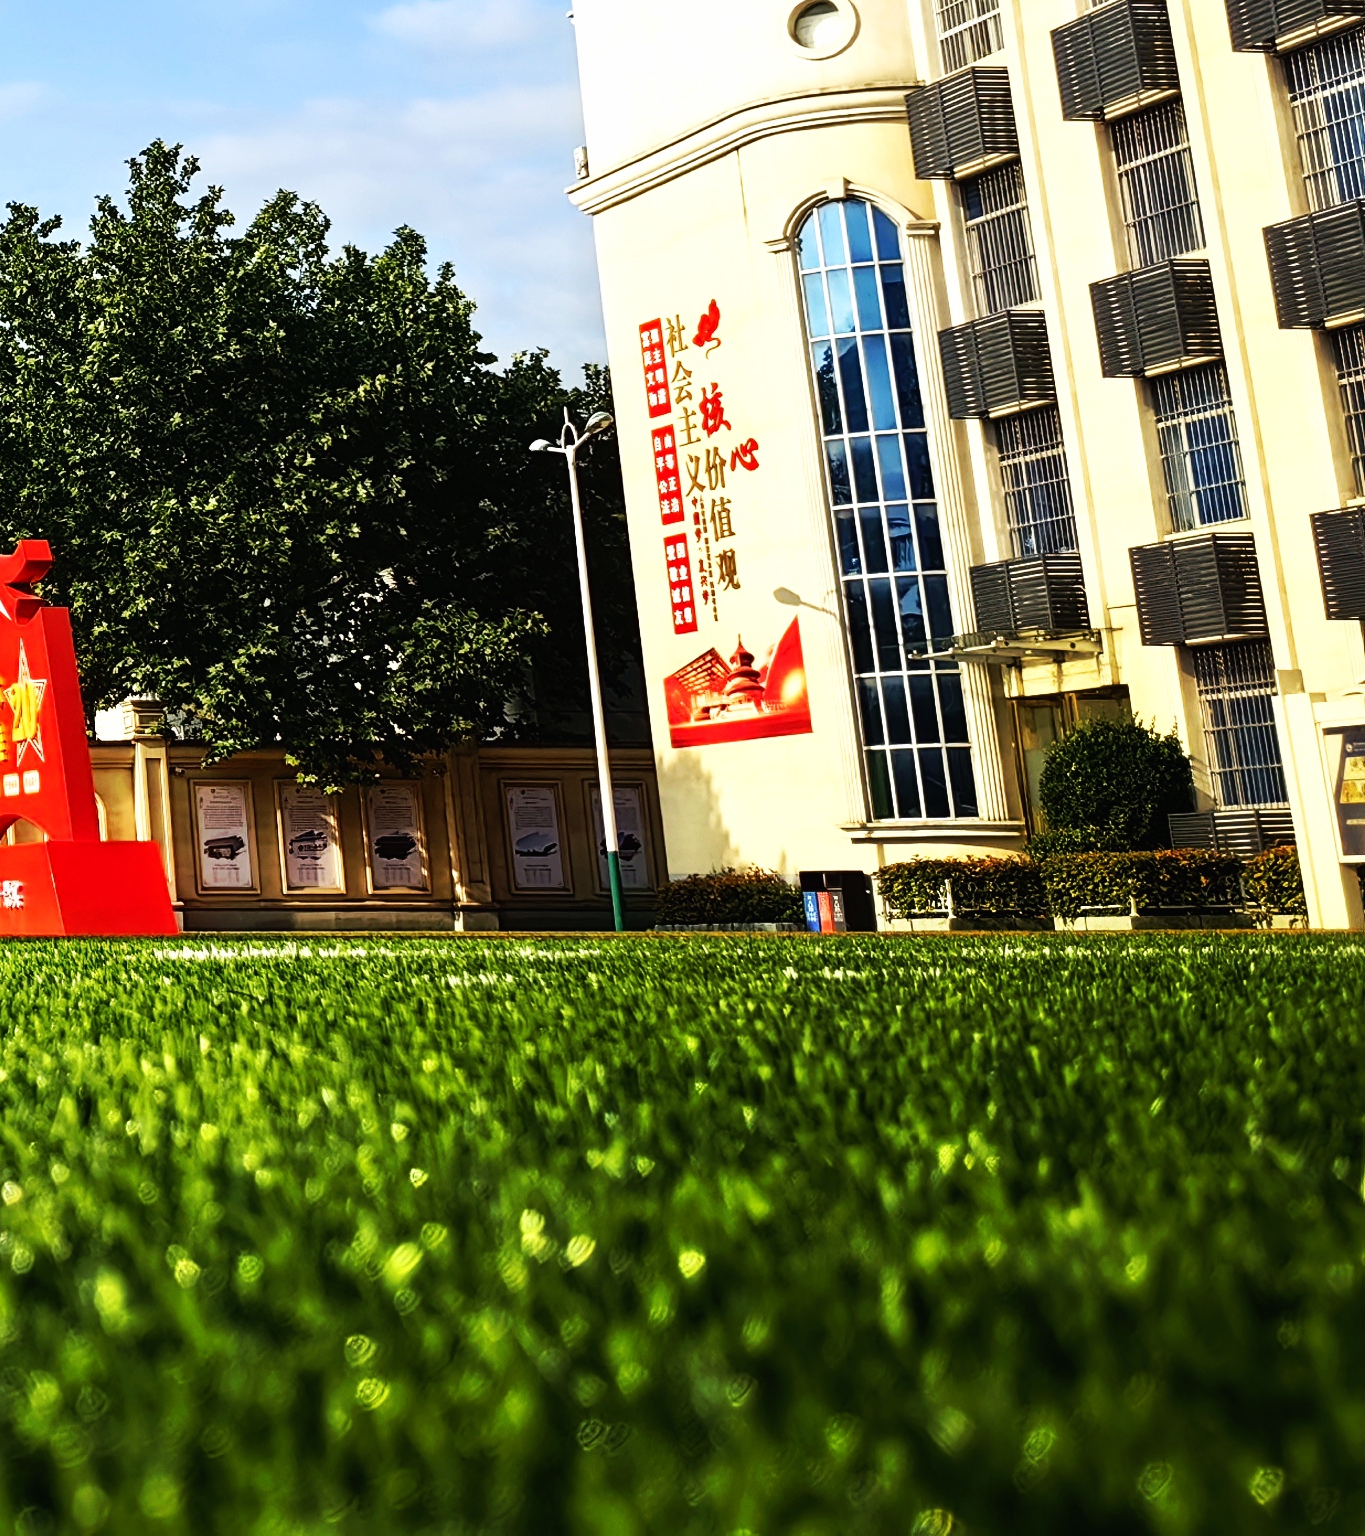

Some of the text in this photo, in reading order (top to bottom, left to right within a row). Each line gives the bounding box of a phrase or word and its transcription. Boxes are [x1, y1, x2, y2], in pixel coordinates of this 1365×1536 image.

[653, 432, 673, 453] 自由
[664, 313, 707, 498] 社会主义
[704, 445, 742, 592] 价值观
[11, 682, 40, 743] 20
